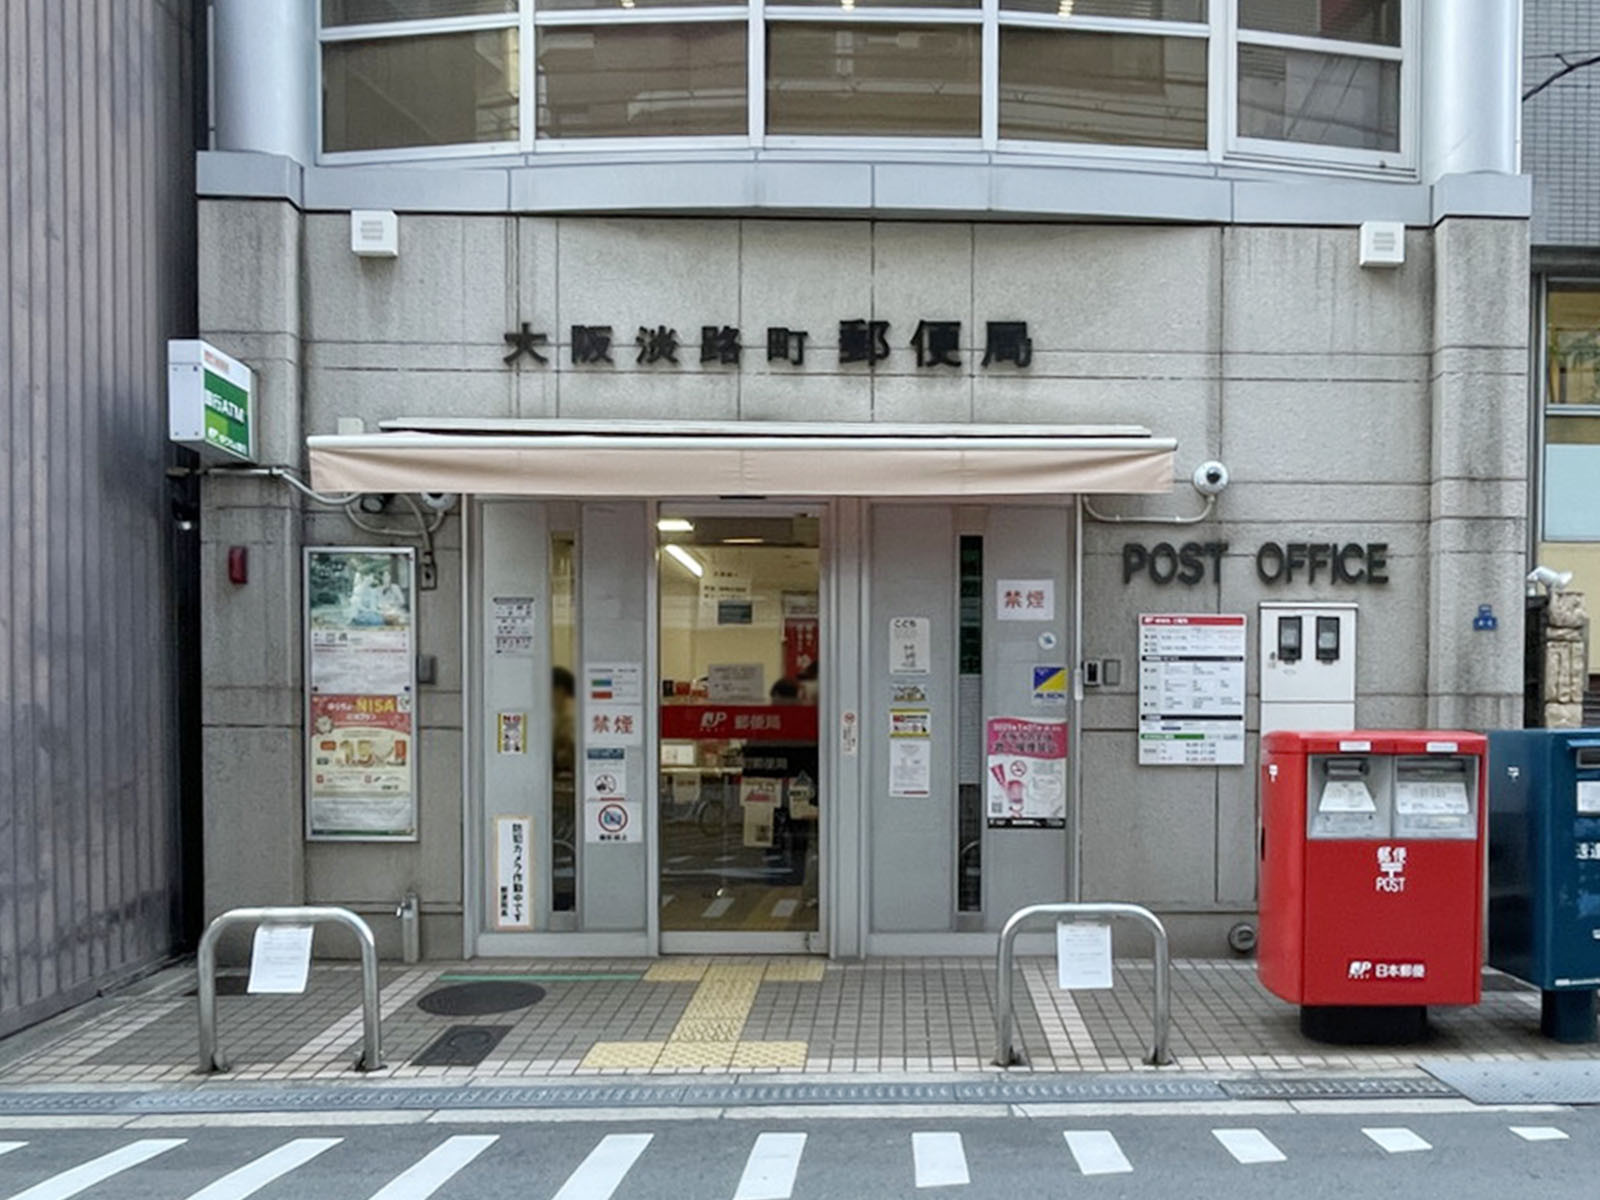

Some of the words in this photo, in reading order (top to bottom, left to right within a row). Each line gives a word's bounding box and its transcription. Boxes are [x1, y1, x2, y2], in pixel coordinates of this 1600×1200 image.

[503, 319, 1033, 367] 大阪淡路町郵便局
[1122, 542, 1230, 585] POST
[1256, 541, 1389, 585] OFFICE
[1004, 590, 1045, 609] 禁煙
[356, 697, 395, 713] NISA
[592, 714, 633, 734] 禁煙
[1376, 876, 1406, 893] POST
